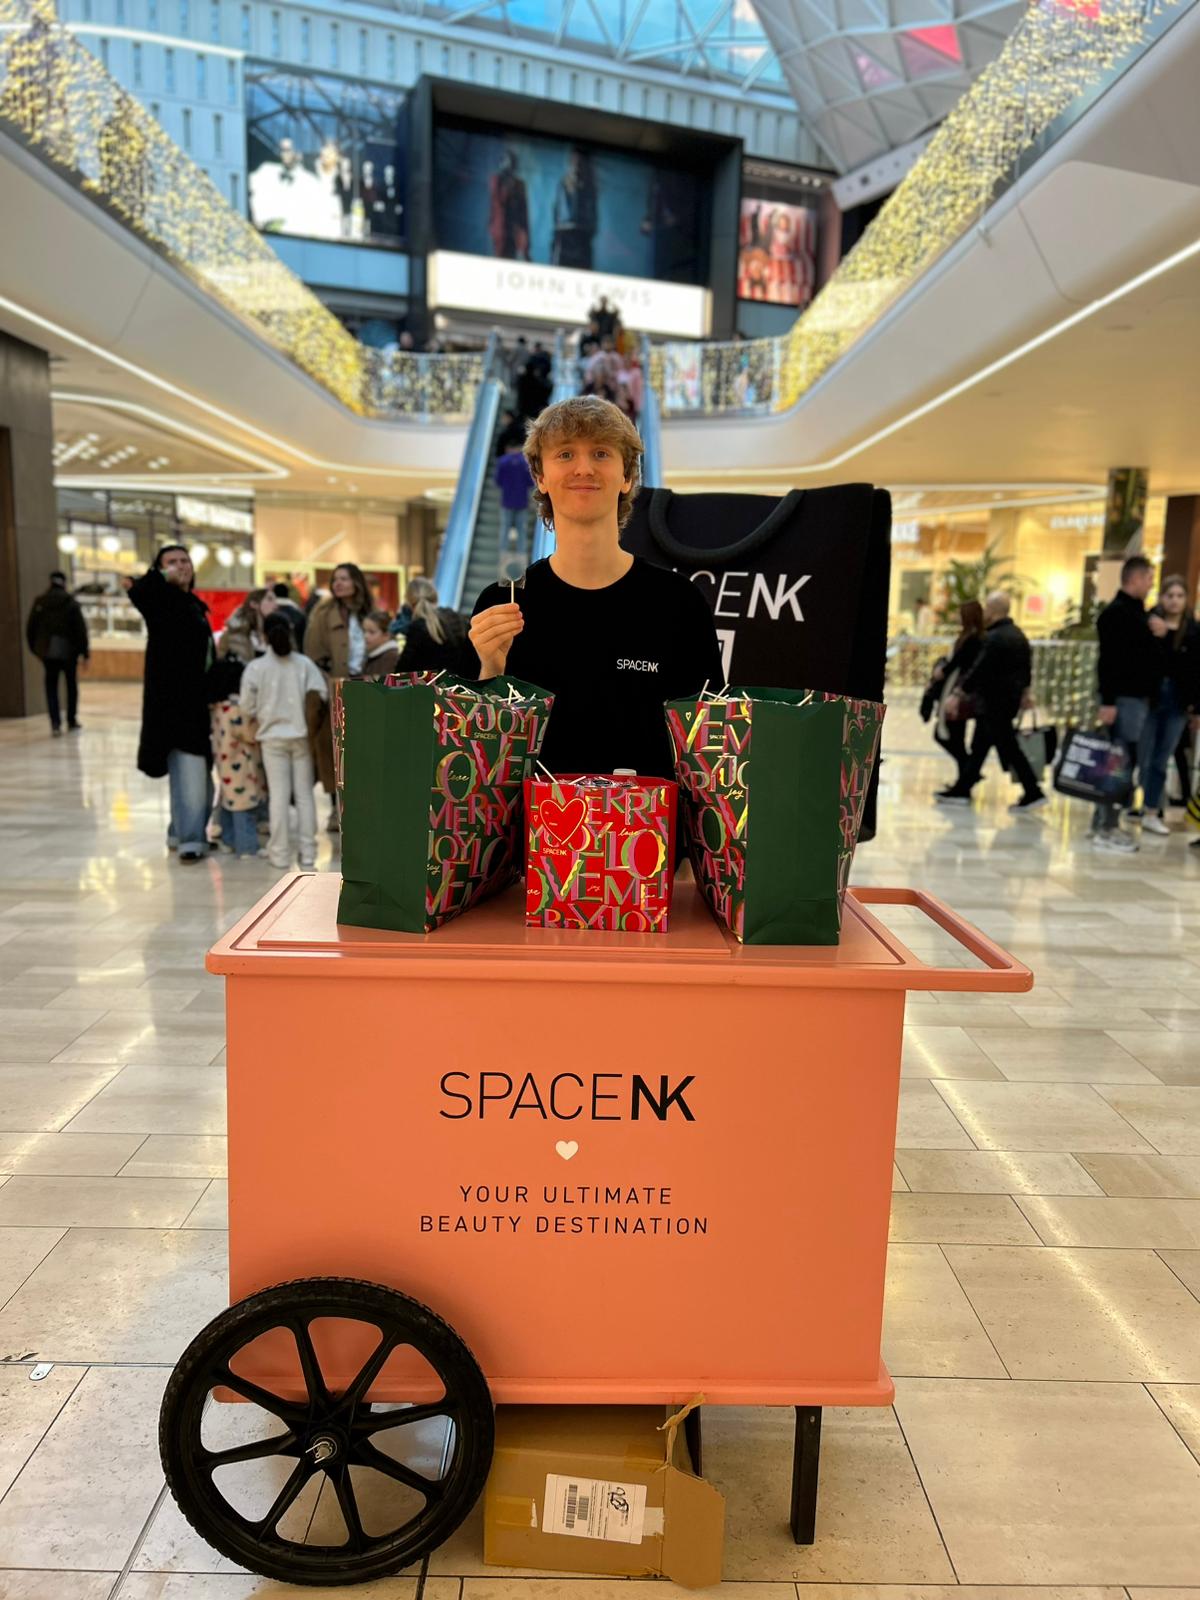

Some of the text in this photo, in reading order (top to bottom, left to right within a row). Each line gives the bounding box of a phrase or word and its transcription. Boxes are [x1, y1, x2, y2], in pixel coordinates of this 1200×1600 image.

[496, 269, 565, 295] JOHN
[575, 280, 652, 307] LEWIS
[459, 1185, 672, 1205] YOUR ULTIMATE
[420, 1215, 708, 1235] BEAUTY DESTINATION
